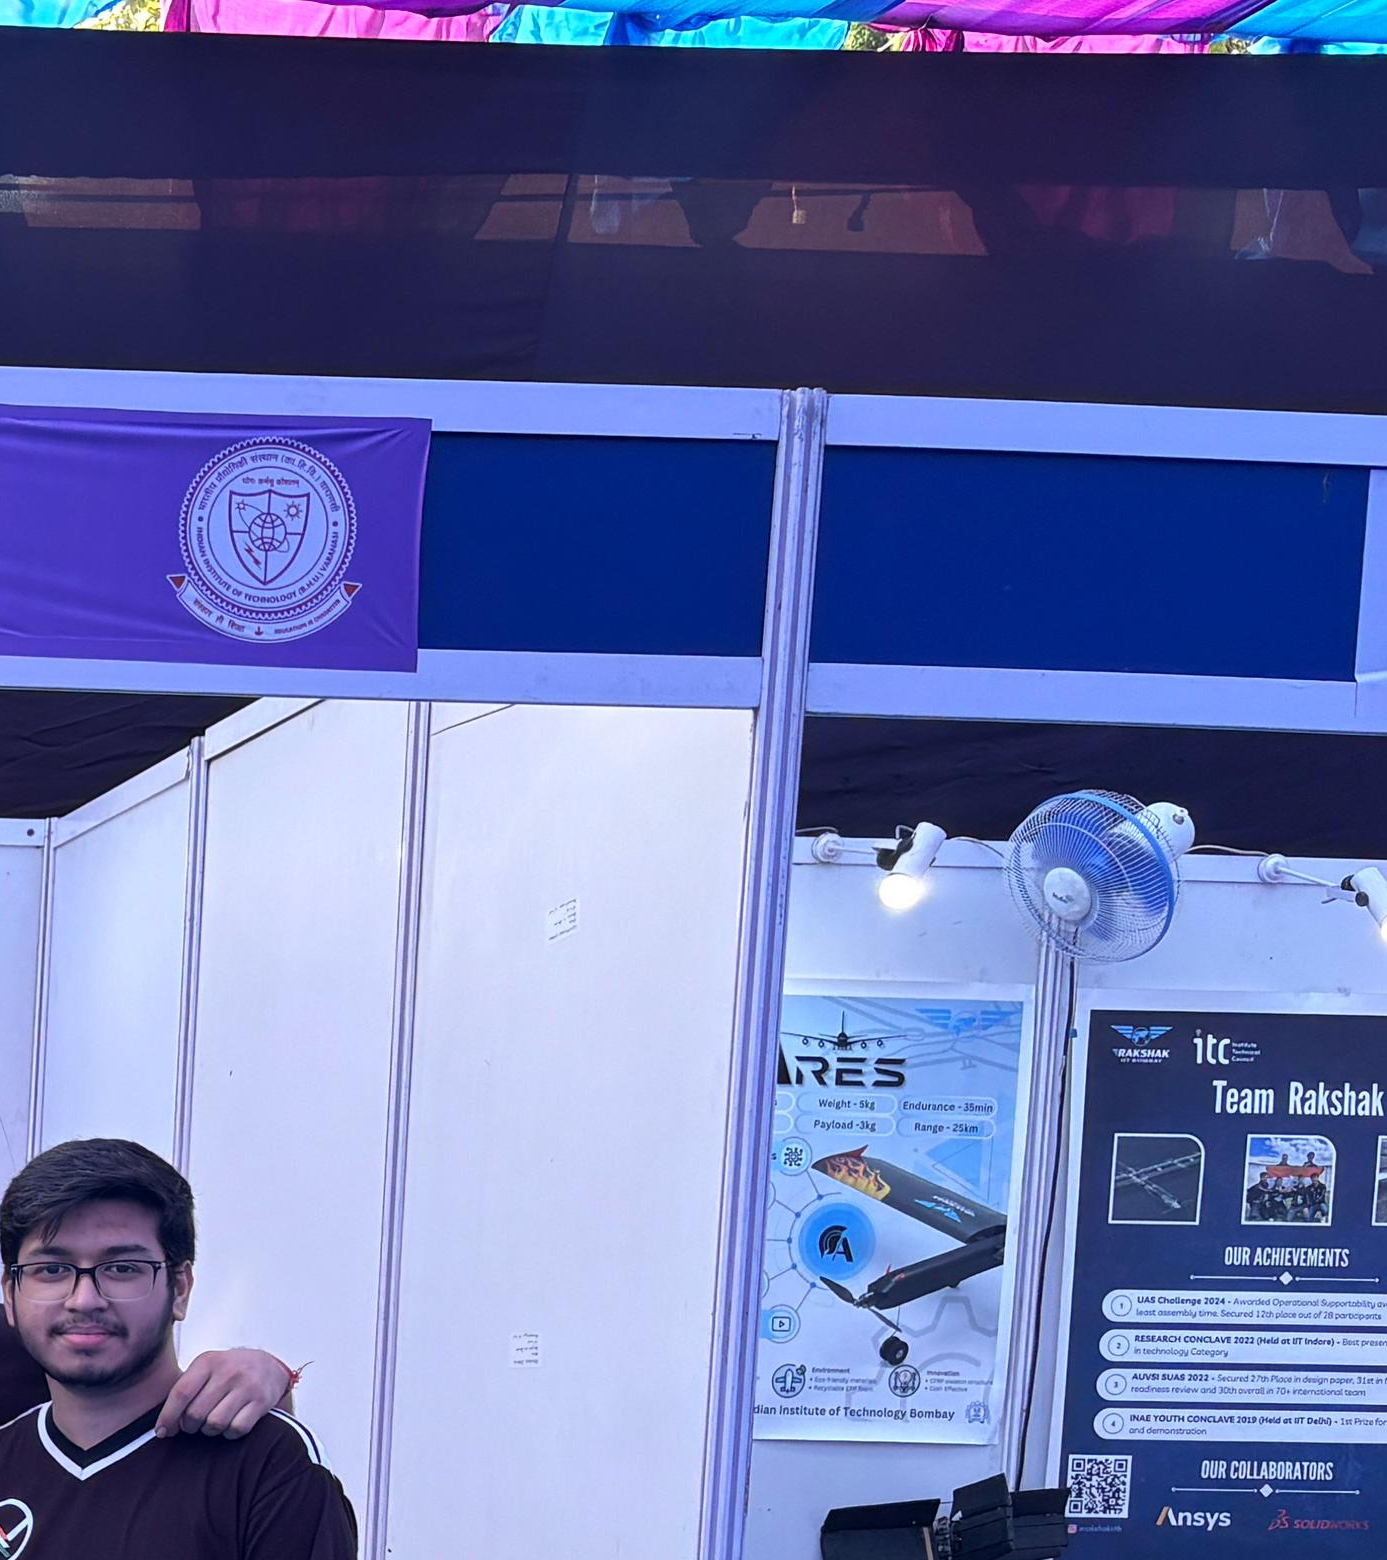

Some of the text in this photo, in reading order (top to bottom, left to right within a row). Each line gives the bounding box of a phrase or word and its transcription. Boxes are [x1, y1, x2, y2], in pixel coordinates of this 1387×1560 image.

[195, 526, 208, 560] INDIAN
[203, 554, 232, 592] INSTITUTE
[231, 586, 244, 598] OF
[320, 531, 340, 575] VARANASI
[1118, 1047, 1171, 1059] RAKSHAK
[818, 1098, 851, 1110] Weight
[859, 1099, 876, 1111] 5kg
[1212, 1080, 1385, 1117] Team Rakshak
[902, 1101, 955, 1112] Endurance
[963, 1103, 994, 1114] 35min
[813, 1119, 853, 1132] Payload
[914, 1122, 944, 1134] Range
[952, 1123, 978, 1134] 25km
[1224, 1246, 1350, 1268] OUR ACHIEVEMENTS
[1137, 1296, 1156, 1304] UAS
[1157, 1296, 1202, 1306] Challenge
[1204, 1297, 1226, 1305] 2024
[1233, 1297, 1271, 1306] Awarded
[1272, 1298, 1319, 1308] Operational
[1321, 1298, 1376, 1309] Supportability
[1135, 1308, 1156, 1317] least
[1157, 1309, 1197, 1319] assembly
[1220, 1309, 1254, 1319] Secured
[1256, 1310, 1275, 1319] 12th
[1275, 1311, 1296, 1320] place
[1312, 1311, 1322, 1319] of
[1323, 1311, 1333, 1319] 28
[1334, 1312, 1382, 1321] participants
[1134, 1335, 1181, 1343] RESEARCH
[1183, 1335, 1232, 1344] CONCLAVE
[1233, 1336, 1255, 1345] 2022
[1256, 1336, 1279, 1346] (Held
[1304, 1338, 1335, 1347] Indore)
[1342, 1338, 1360, 1346] Best
[1142, 1347, 1189, 1357] technology
[1190, 1348, 1229, 1358] Category
[1131, 1373, 1160, 1381] AUVSI
[1161, 1373, 1186, 1381] SUAS
[1187, 1373, 1209, 1382] 2022
[1217, 1374, 1249, 1383] Secured
[1251, 1374, 1269, 1383] 27th
[1270, 1375, 1293, 1384] Place
[1302, 1376, 1329, 1385] design
[1356, 1376, 1374, 1385] 31st
[1375, 1377, 1383, 1385] in
[1130, 1385, 1170, 1393] readiness
[1171, 1386, 1199, 1394] review
[1200, 1386, 1217, 1394] and
[1218, 1387, 1237, 1395] 30th
[1238, 1387, 1265, 1395] overall
[1266, 1387, 1274, 1395] in
[1292, 1387, 1343, 1396] international
[1344, 1388, 1366, 1397] team
[779, 1404, 826, 1417] Institute
[827, 1406, 842, 1417] of
[842, 1406, 907, 1421] Technology
[909, 1408, 955, 1421] Bombay
[1129, 1414, 1151, 1422] INAE
[1152, 1414, 1185, 1423] YOUTH
[1186, 1414, 1235, 1424] CONCLAVE
[1236, 1416, 1257, 1424] 2019
[1258, 1416, 1281, 1425] (Held
[1282, 1417, 1293, 1425] at
[1307, 1417, 1332, 1426] Delhi)
[1340, 1418, 1353, 1426] 1st
[1354, 1418, 1374, 1426] Prize
[1374, 1418, 1387, 1426] for
[1146, 1427, 1207, 1435] demonstration
[1200, 1460, 1334, 1481] OUR COLLABORATORS
[1155, 1505, 1232, 1532] Ansys
[1293, 1518, 1371, 1530] SOLIDWORKS
